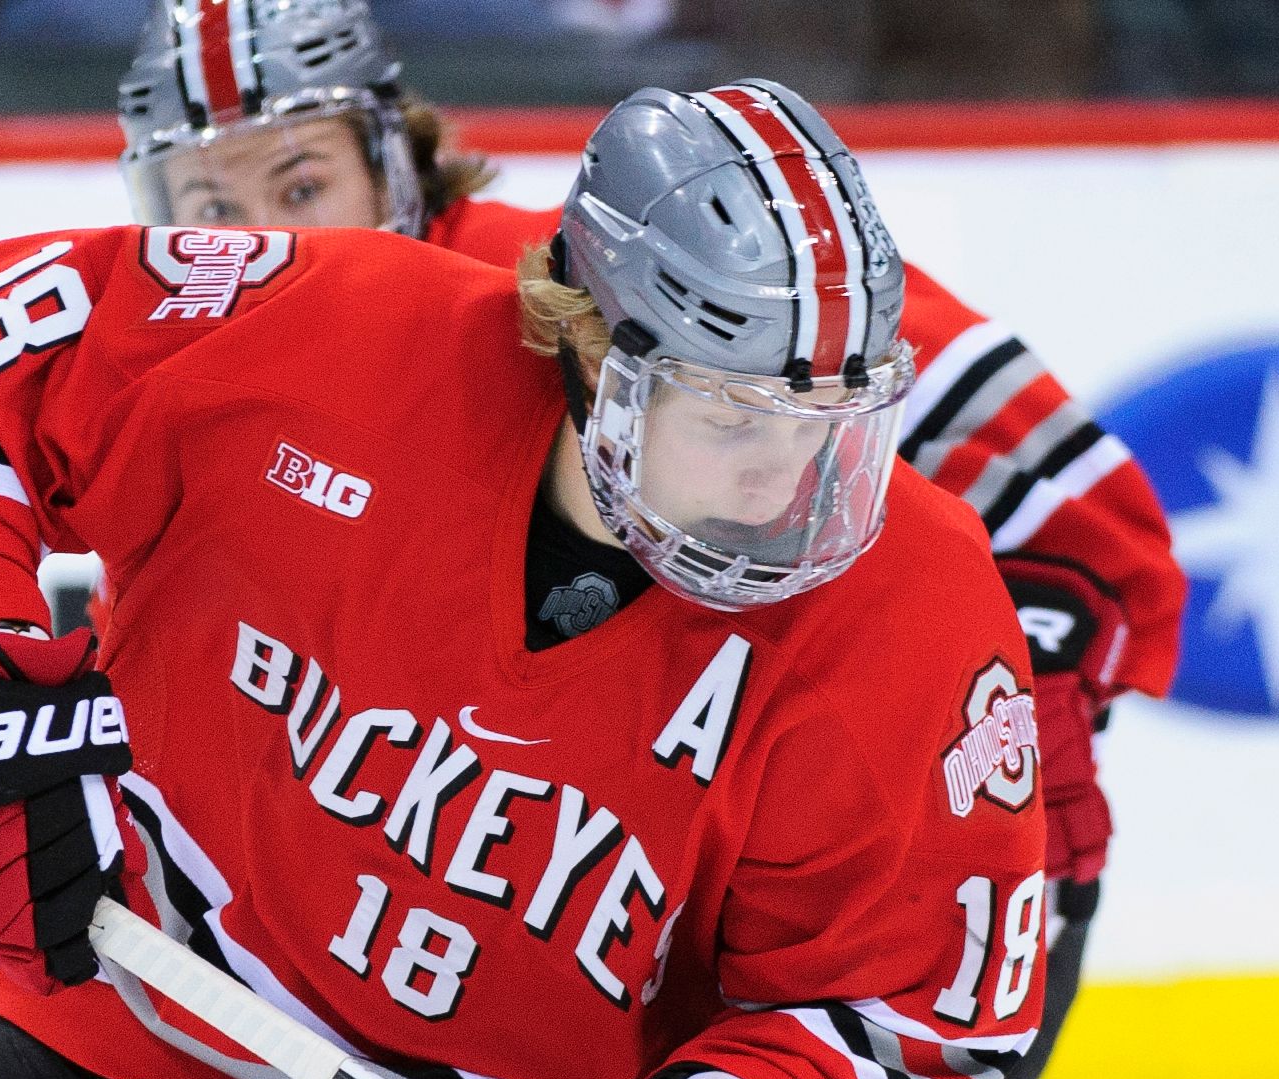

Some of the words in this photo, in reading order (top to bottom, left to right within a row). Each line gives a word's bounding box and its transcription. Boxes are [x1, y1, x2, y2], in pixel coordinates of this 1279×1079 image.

[651, 632, 752, 787] A
[327, 873, 481, 1018] 18
[933, 870, 1046, 1027] 18
